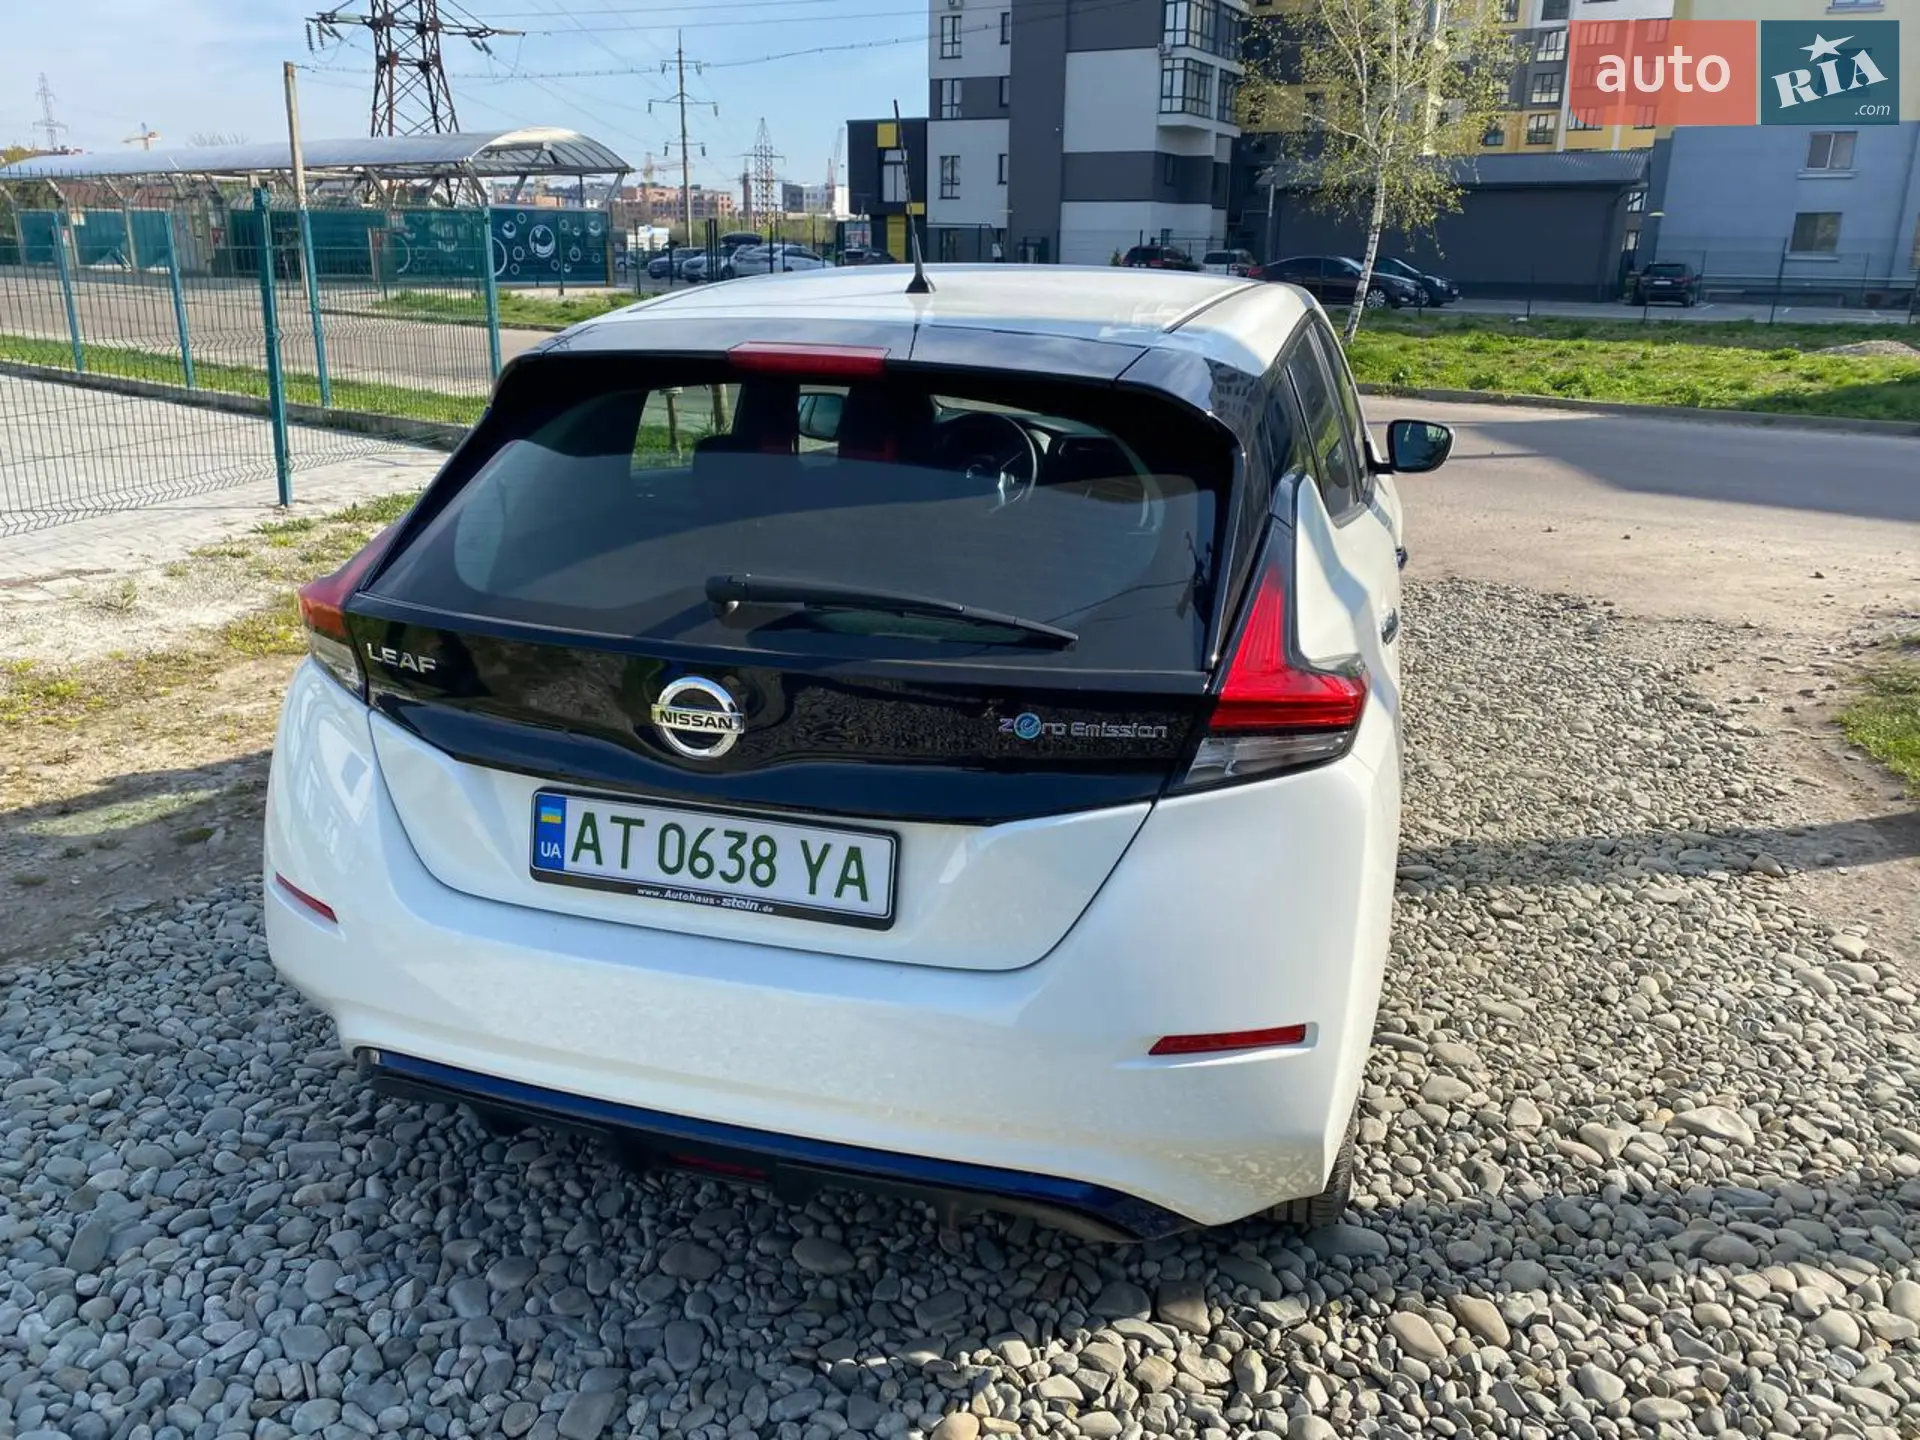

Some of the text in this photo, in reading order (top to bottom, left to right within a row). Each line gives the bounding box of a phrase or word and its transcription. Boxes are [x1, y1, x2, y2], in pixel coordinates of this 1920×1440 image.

[366, 642, 436, 673] LEAF
[660, 710, 733, 729] NISSAN
[1070, 721, 1168, 738] Emission
[540, 840, 562, 859] UA
[571, 811, 868, 902] AT 0638 YA
